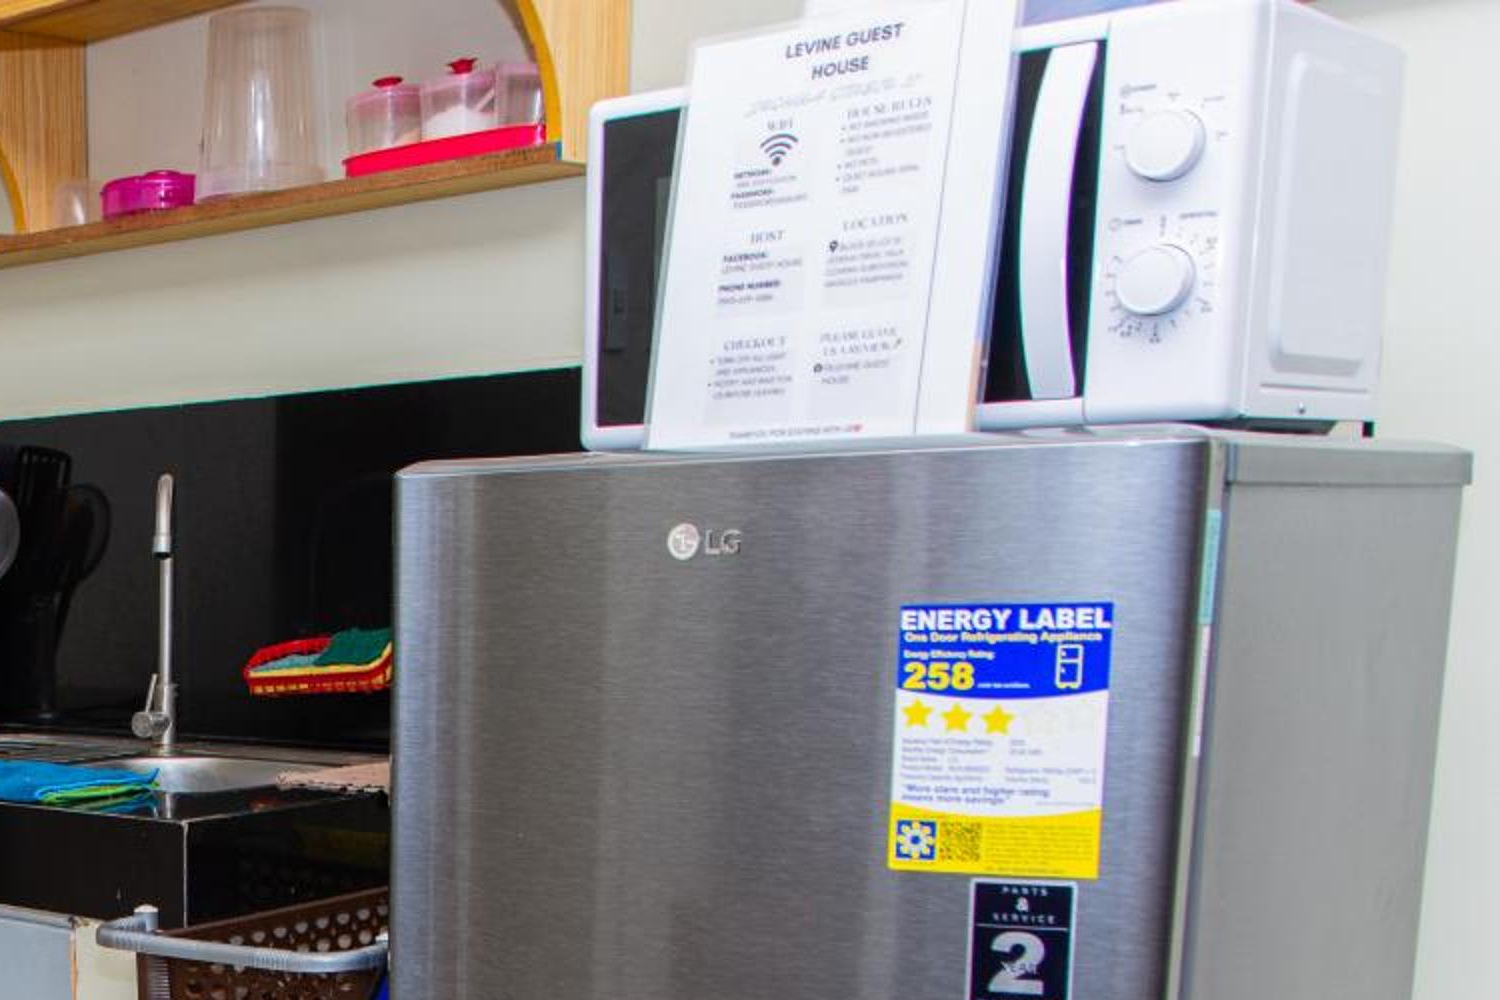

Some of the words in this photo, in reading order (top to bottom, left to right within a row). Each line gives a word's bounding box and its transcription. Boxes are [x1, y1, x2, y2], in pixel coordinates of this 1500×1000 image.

[785, 35, 841, 59] LEVINE
[845, 22, 905, 46] GUEST
[810, 55, 870, 80] HOUSE
[705, 529, 742, 555] LG
[900, 608, 1012, 631] ENERGY
[1018, 606, 1113, 630] LABEL
[903, 632, 928, 643] One
[930, 631, 958, 643] Door
[961, 631, 1039, 645] Refrigerating
[1040, 630, 1103, 645] Appliance
[902, 661, 975, 691] 258
[1001, 885, 1049, 897] PARTS
[1015, 897, 1029, 912] &
[991, 912, 1057, 925] SERVICE
[988, 931, 1045, 996] 2
